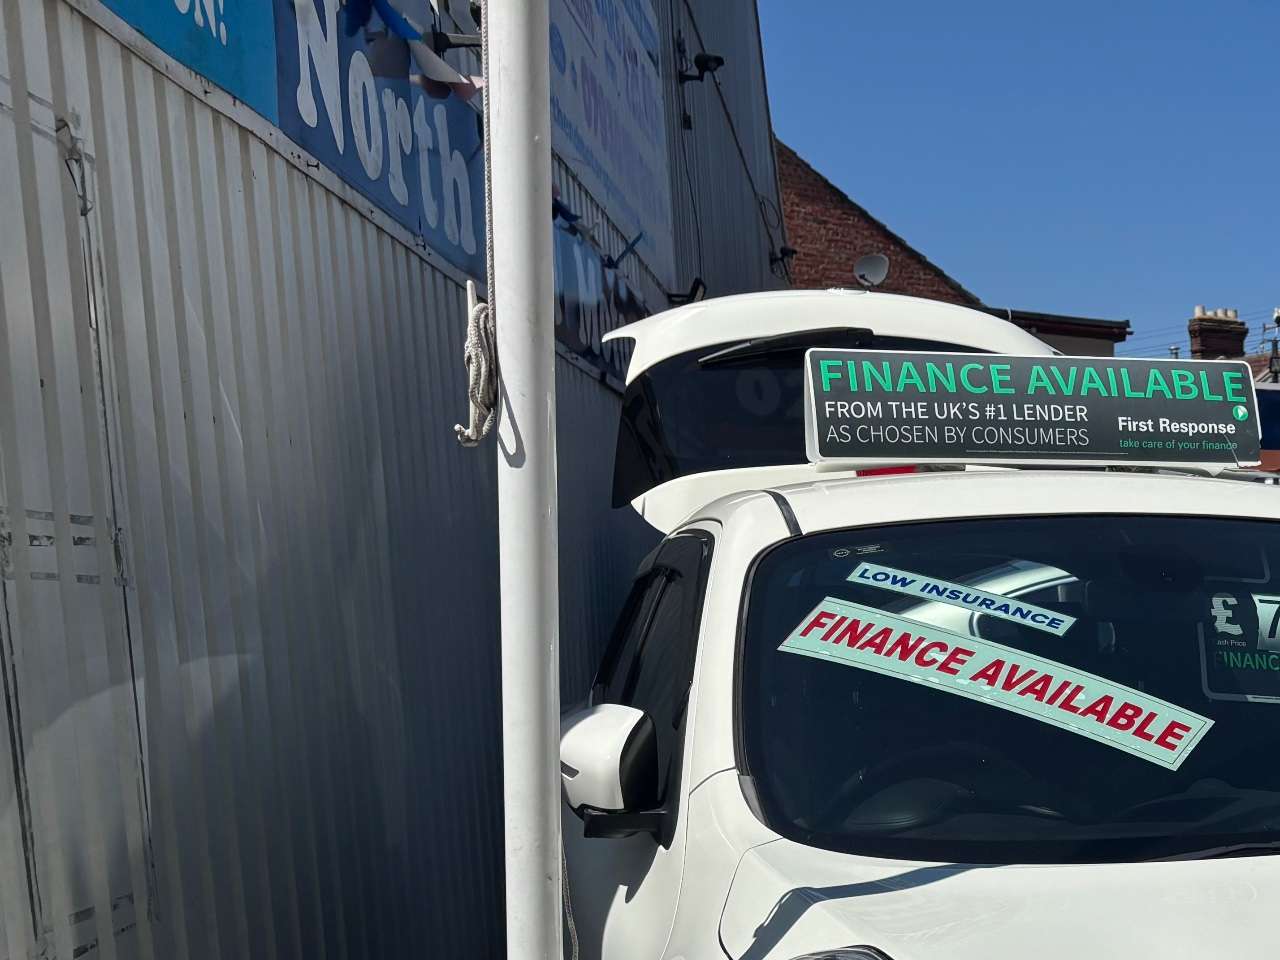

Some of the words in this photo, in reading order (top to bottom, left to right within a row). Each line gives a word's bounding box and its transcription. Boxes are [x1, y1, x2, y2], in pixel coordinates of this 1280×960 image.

[294, 0, 477, 255] North
[820, 360, 1016, 394] FINANCE
[1027, 365, 1247, 402] AVAILABLE
[825, 401, 883, 418] FROM
[888, 402, 929, 419] THE
[934, 402, 980, 420] UK'S
[985, 403, 1007, 420] #1
[1013, 403, 1089, 422] LENDER
[1118, 416, 1154, 432] First
[1159, 418, 1236, 436] Response
[826, 425, 852, 443] AS
[856, 425, 938, 443] CHOSEN
[944, 426, 967, 444] BY
[972, 426, 1089, 446] CONSUMERS
[1119, 439, 1139, 448] take
[1142, 440, 1163, 449] care
[1165, 439, 1175, 449] of
[1178, 440, 1200, 450] your
[858, 567, 917, 589] LOW
[919, 580, 1065, 630] INSURANCE
[799, 610, 977, 676] FINANCE
[969, 658, 1193, 752] AVAILABLE
